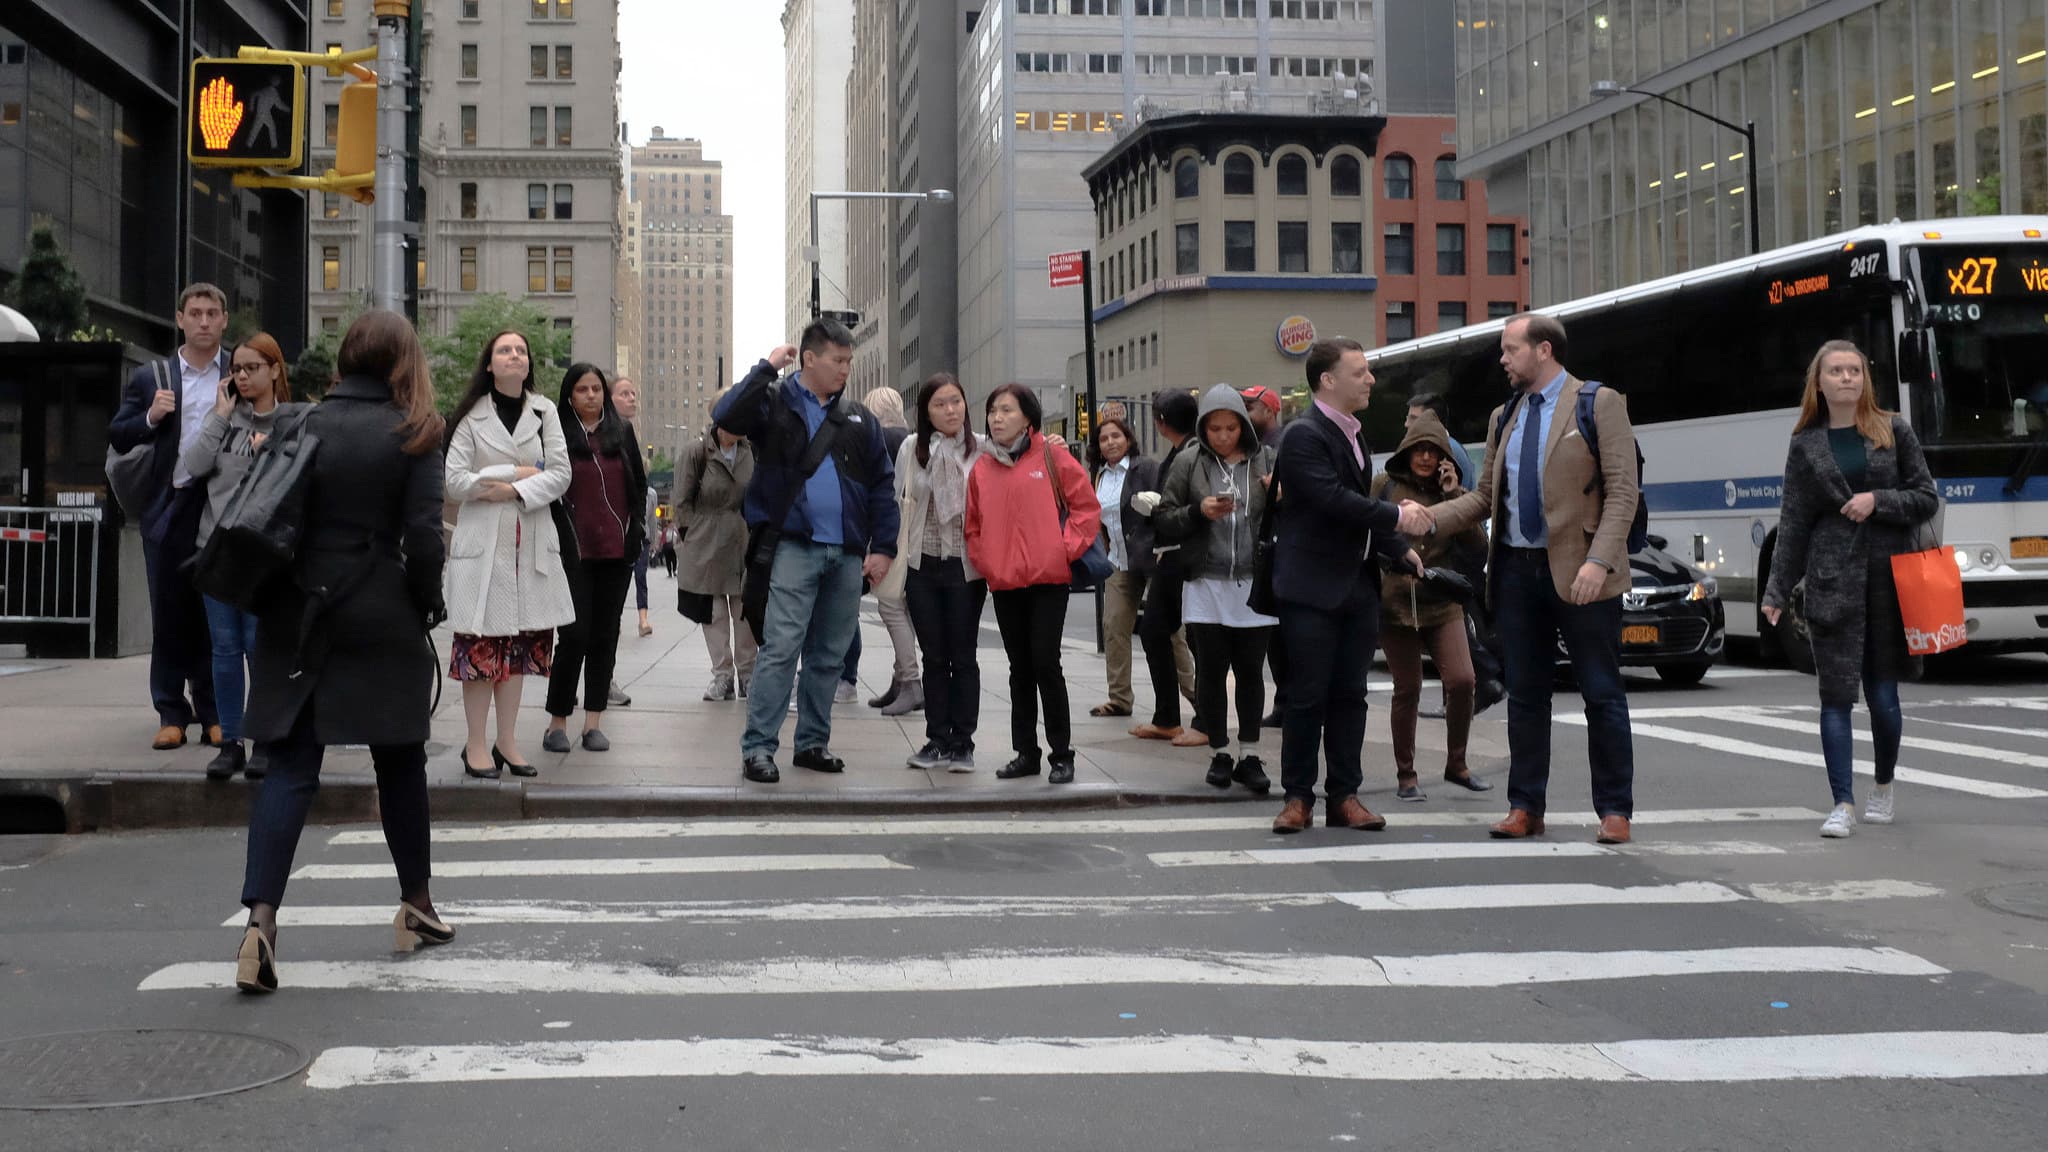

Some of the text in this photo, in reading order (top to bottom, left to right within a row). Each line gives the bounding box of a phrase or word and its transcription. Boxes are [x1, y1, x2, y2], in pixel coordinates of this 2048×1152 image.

[1050, 256, 1058, 264] NO
[1850, 253, 1880, 278] 2417
[1051, 264, 1072, 272] Anytime
[1947, 257, 2048, 295] x27 via
[1768, 280, 1783, 304] x27
[1794, 274, 1829, 296] BROADWAY
[1280, 321, 1312, 338] BURGER
[1282, 329, 1313, 347] KING
[1737, 488, 1750, 497] New
[1750, 487, 1763, 497] York
[1763, 486, 1776, 498] City
[1946, 484, 1976, 497] 2417
[57, 492, 95, 506] PLEASE DO NOT
